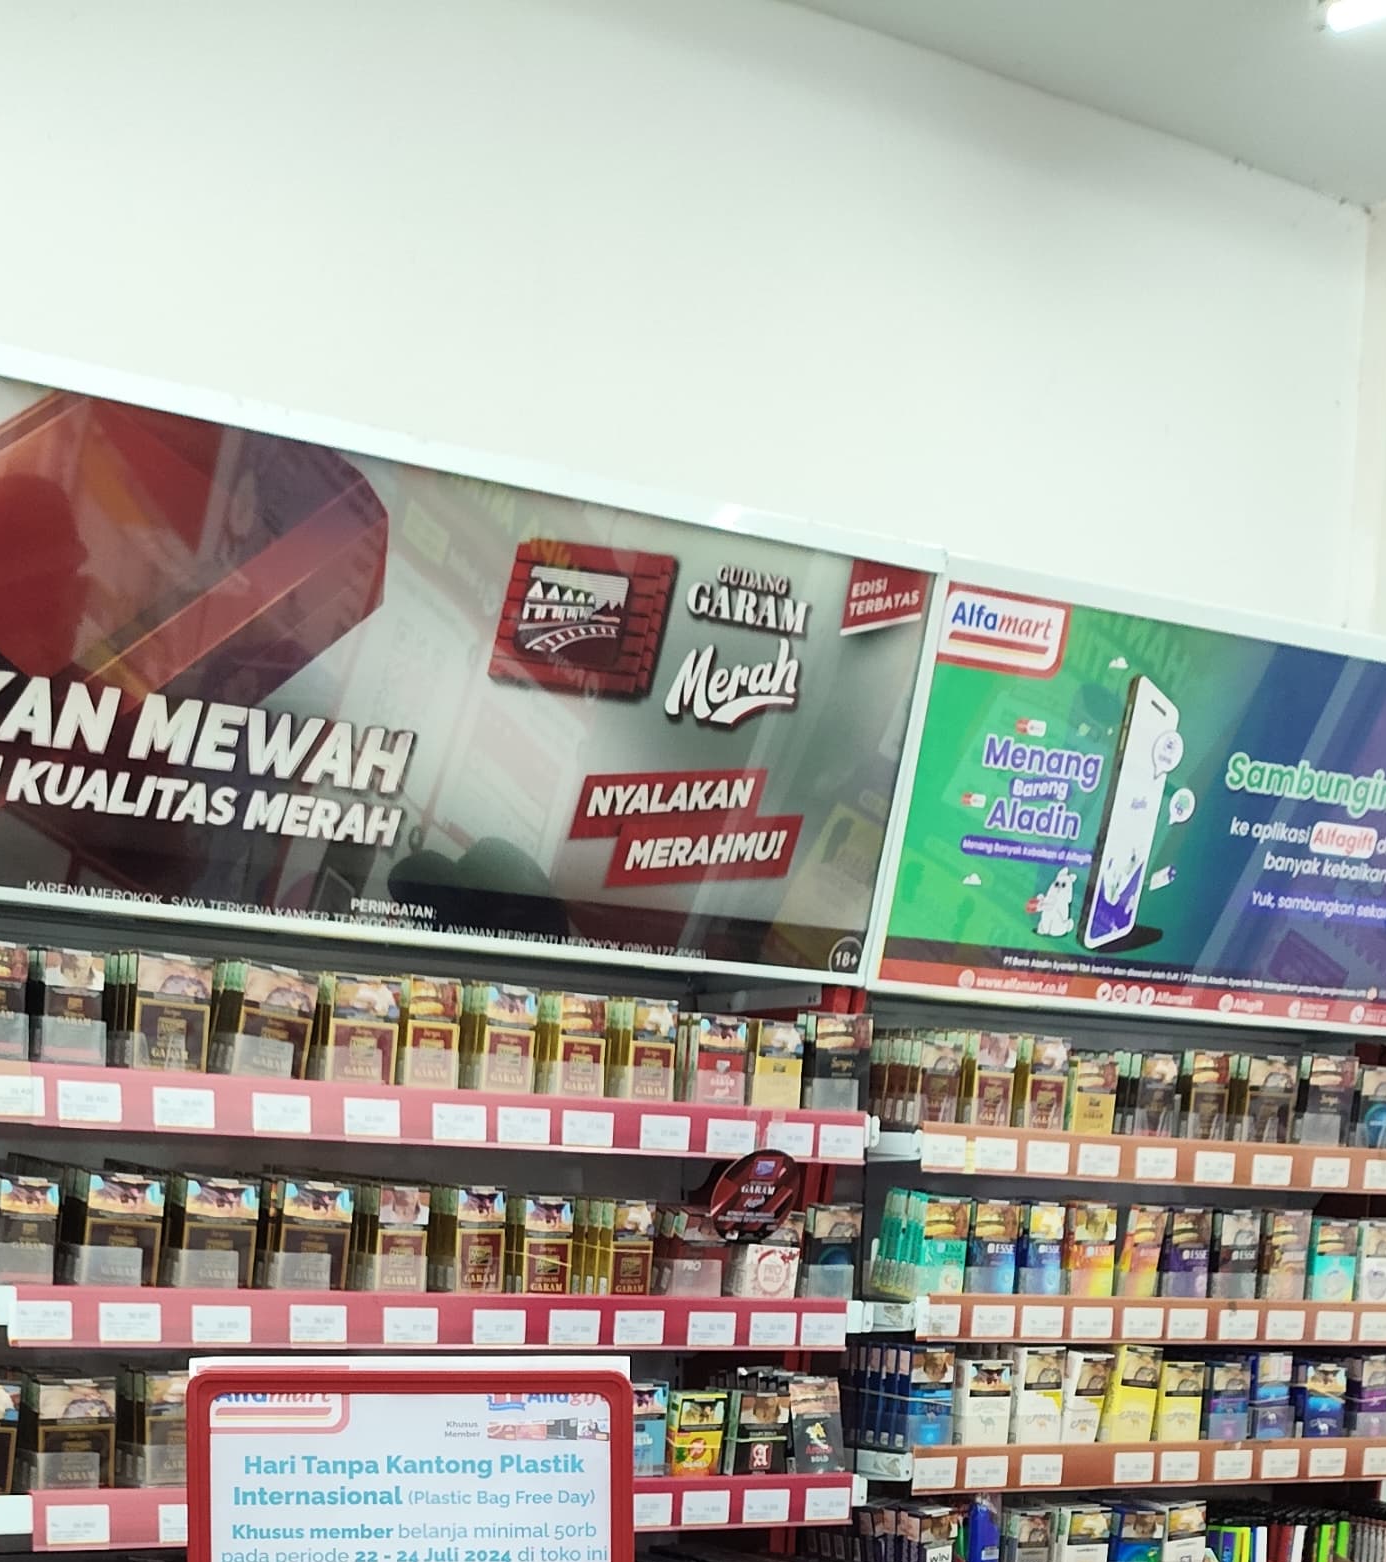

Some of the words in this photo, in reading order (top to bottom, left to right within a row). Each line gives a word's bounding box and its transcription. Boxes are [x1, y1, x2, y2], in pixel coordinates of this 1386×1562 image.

[717, 565, 789, 595] GUDANG
[852, 578, 888, 598] EDISI
[685, 581, 812, 635] GARAM
[849, 591, 919, 617] TERBATAS
[952, 600, 1053, 641] Alfamart
[665, 639, 799, 724] Merah
[130, 692, 416, 793] MEWAH
[983, 734, 1103, 792] Menang
[587, 778, 754, 817] NYALAKAN
[1013, 779, 1068, 799] Bareng
[7, 758, 236, 827] KUALITAS
[242, 791, 402, 848] MERAH
[985, 798, 1081, 840] Aladin
[1230, 817, 1247, 836] ke
[1252, 823, 1310, 845] aplikasi
[1313, 824, 1374, 857] Alfagift
[625, 831, 788, 871] MERAHMU!
[1263, 852, 1321, 877] banyak
[351, 898, 437, 920] PERINGATAN:
[1252, 892, 1275, 908] Yuk,
[1278, 895, 1354, 917] sambungkan
[834, 949, 858, 969] 18+
[976, 975, 1068, 997] www.alfamart.co.id
[444, 1430, 481, 1439] Member
[445, 1419, 479, 1430] Khusus
[244, 1455, 297, 1475] Hari
[301, 1456, 380, 1480] Tanpa
[386, 1454, 493, 1480] Kantong
[499, 1453, 585, 1475] Plastik
[233, 1485, 403, 1506] Internasional
[408, 1488, 472, 1507] (Plastic
[476, 1489, 511, 1509] Bag
[516, 1488, 554, 1506] Free
[558, 1488, 596, 1508] Day)
[232, 1523, 305, 1541] Khusus
[309, 1523, 394, 1541] member
[398, 1522, 468, 1544] belanja
[474, 1521, 550, 1539] minimal
[553, 1522, 597, 1541] 50rb
[517, 1546, 535, 1562] di
[540, 1546, 583, 1562] toko
[586, 1545, 609, 1561] ini
